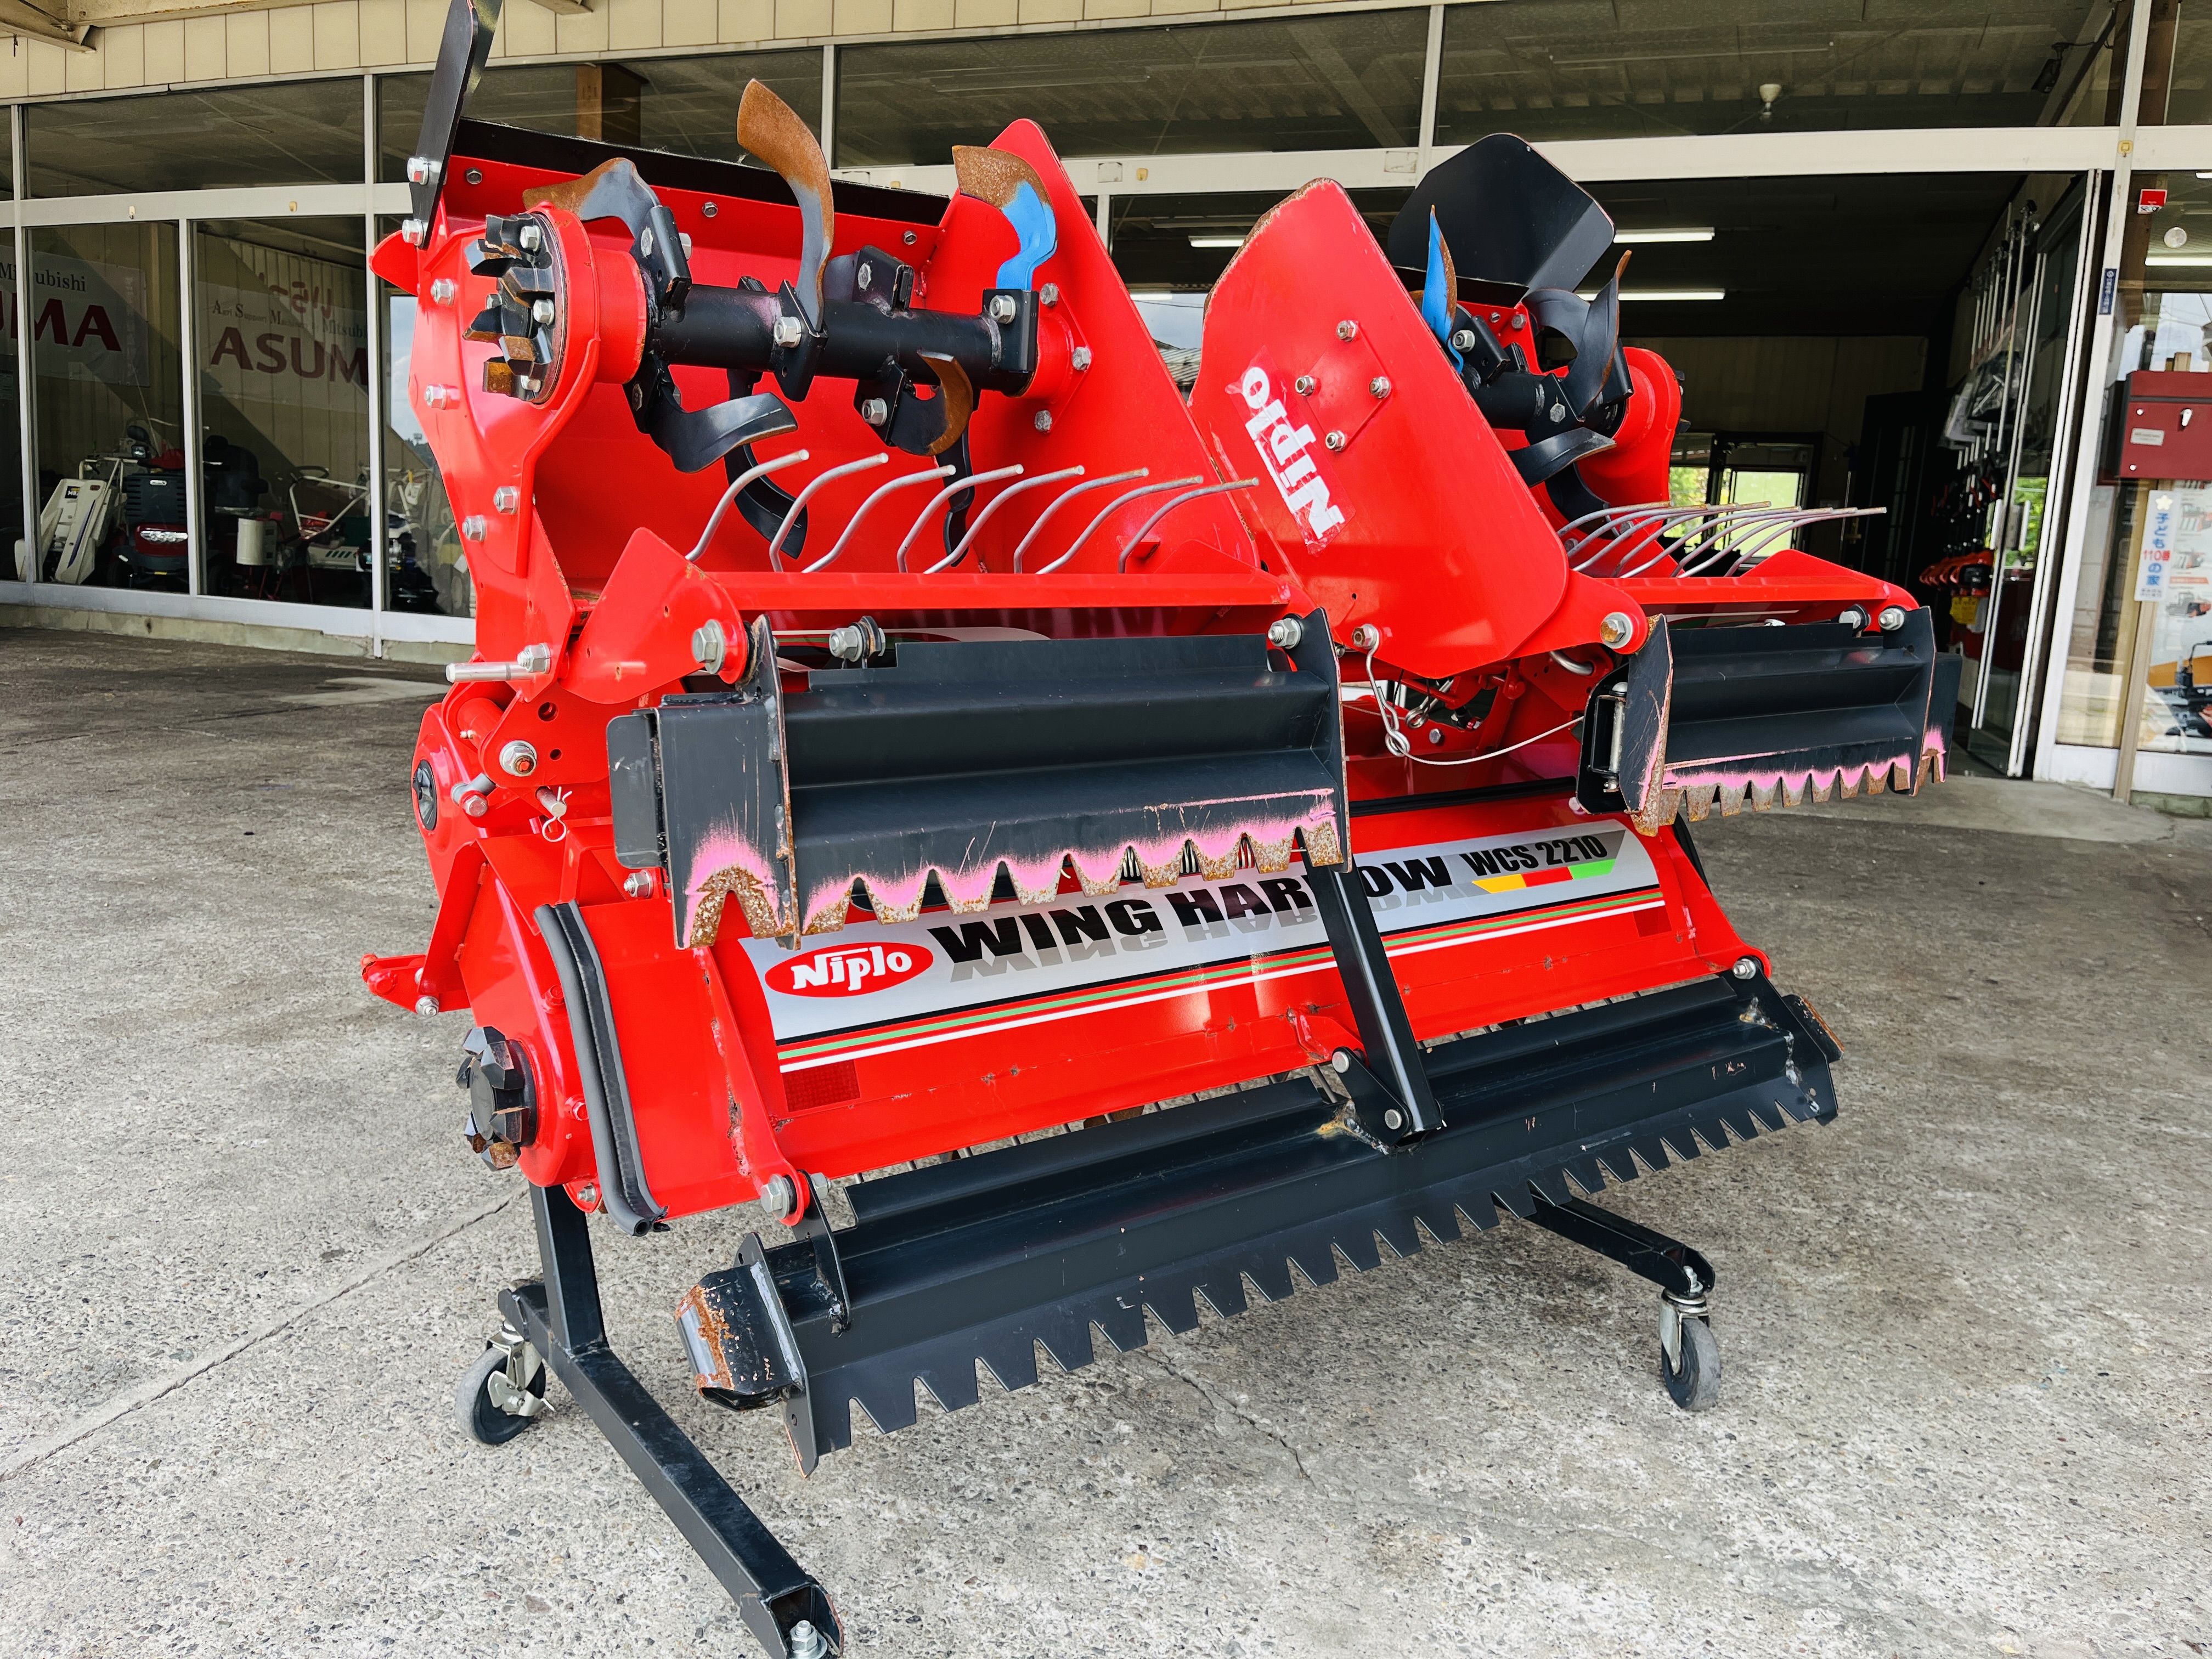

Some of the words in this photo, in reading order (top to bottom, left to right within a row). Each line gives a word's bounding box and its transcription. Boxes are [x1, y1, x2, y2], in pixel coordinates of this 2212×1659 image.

[0, 263, 86, 292] Miubishi
[0, 290, 122, 351] MA
[1242, 366, 1345, 539] Niplo
[1459, 845, 1539, 876] WCS
[1534, 835, 1607, 865] 2210
[927, 899, 1161, 964] WING
[1165, 856, 1453, 926] HAROW
[792, 946, 912, 991] Niplo
